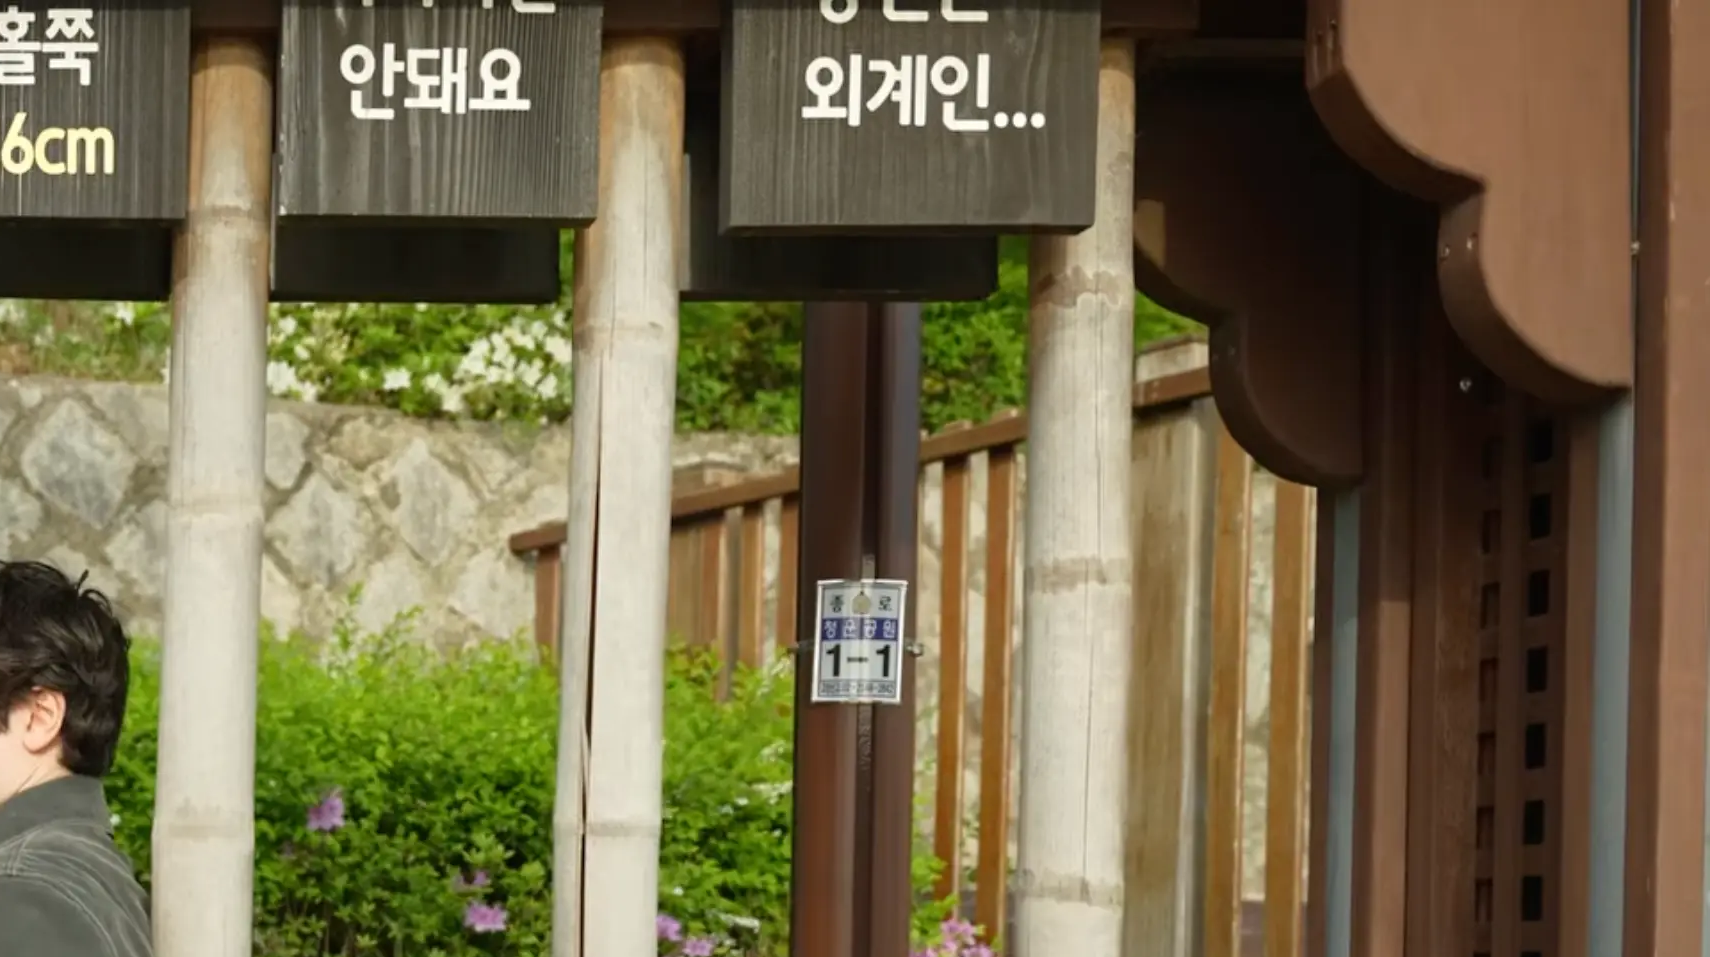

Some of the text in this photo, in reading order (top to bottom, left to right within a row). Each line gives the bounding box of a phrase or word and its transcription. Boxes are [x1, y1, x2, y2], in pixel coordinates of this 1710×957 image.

[339, 43, 532, 120] 안돼요
[800, 53, 1047, 131] 외계인...
[825, 643, 891, 678] 1-1
